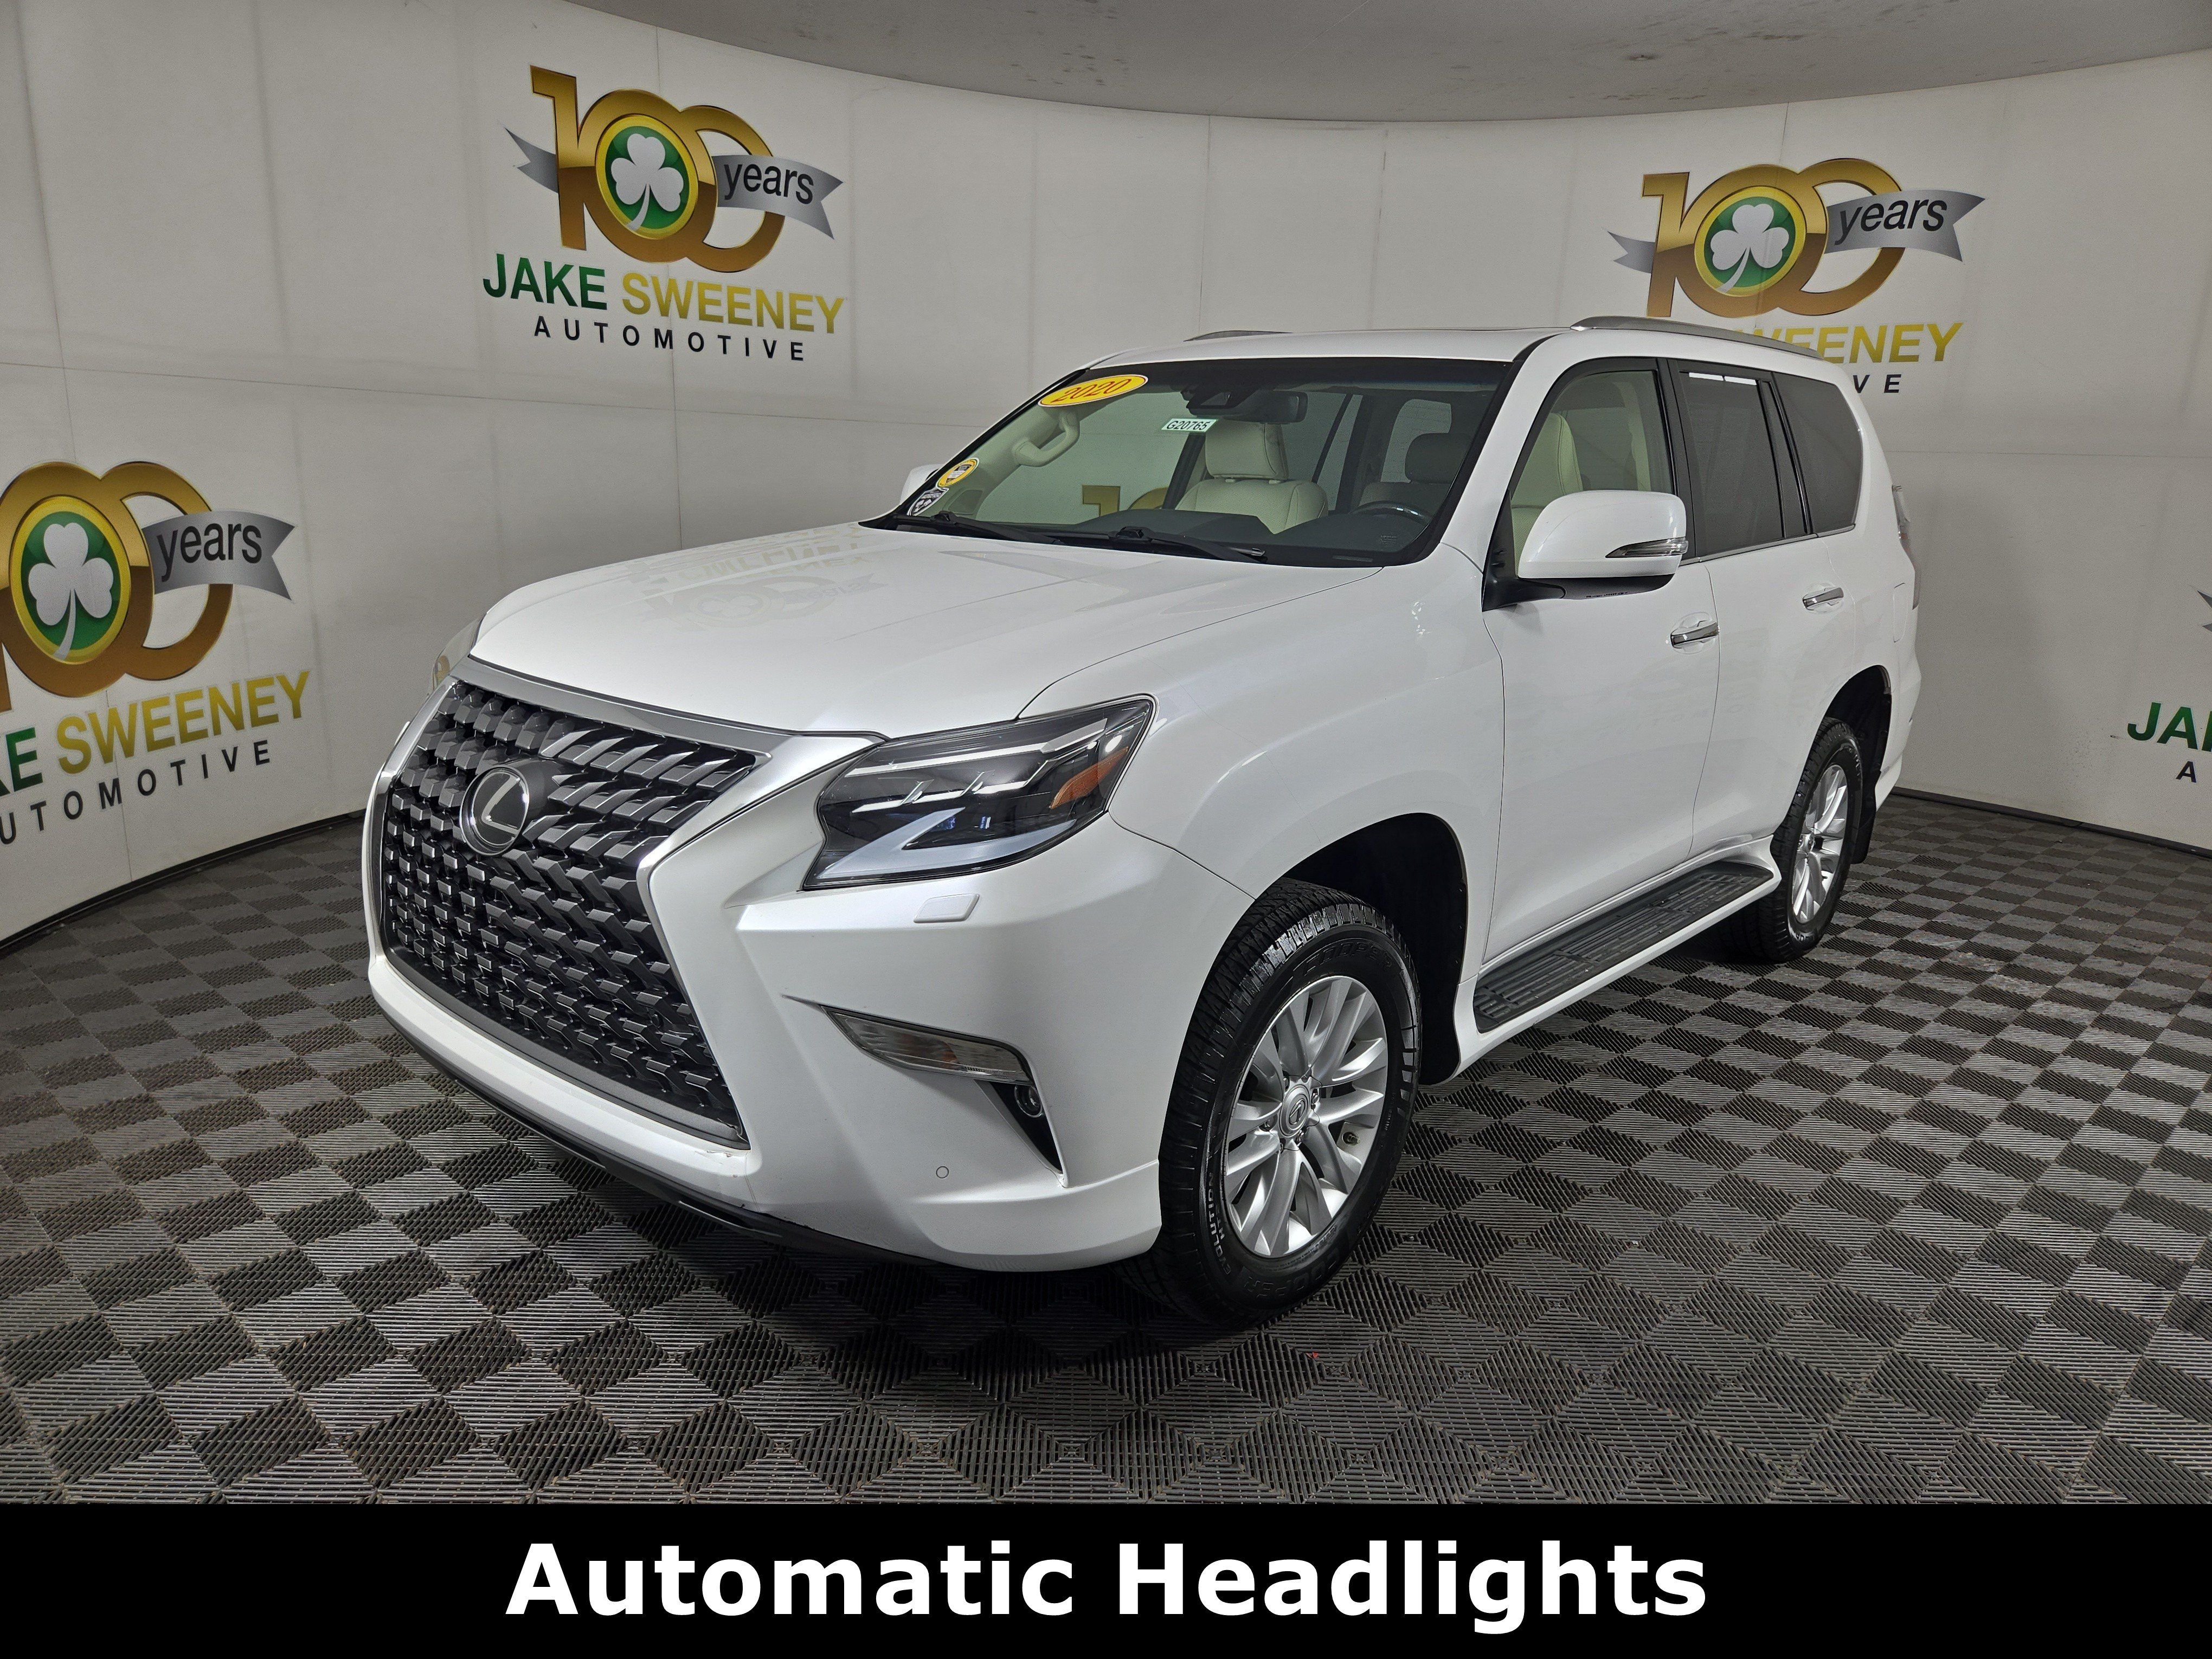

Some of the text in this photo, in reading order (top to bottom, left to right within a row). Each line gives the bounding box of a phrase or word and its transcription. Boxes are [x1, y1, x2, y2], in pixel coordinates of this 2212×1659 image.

[724, 162, 814, 204] years
[1835, 197, 1947, 245] years
[483, 253, 845, 334] JAKE SWEENEY
[534, 316, 804, 362] AUTOMOTIVE
[1735, 322, 1964, 363] EENEY
[1050, 378, 1132, 403] 2020
[1166, 420, 1208, 430] G20765
[156, 522, 263, 582] years
[56, 671, 310, 775] SWEENEY
